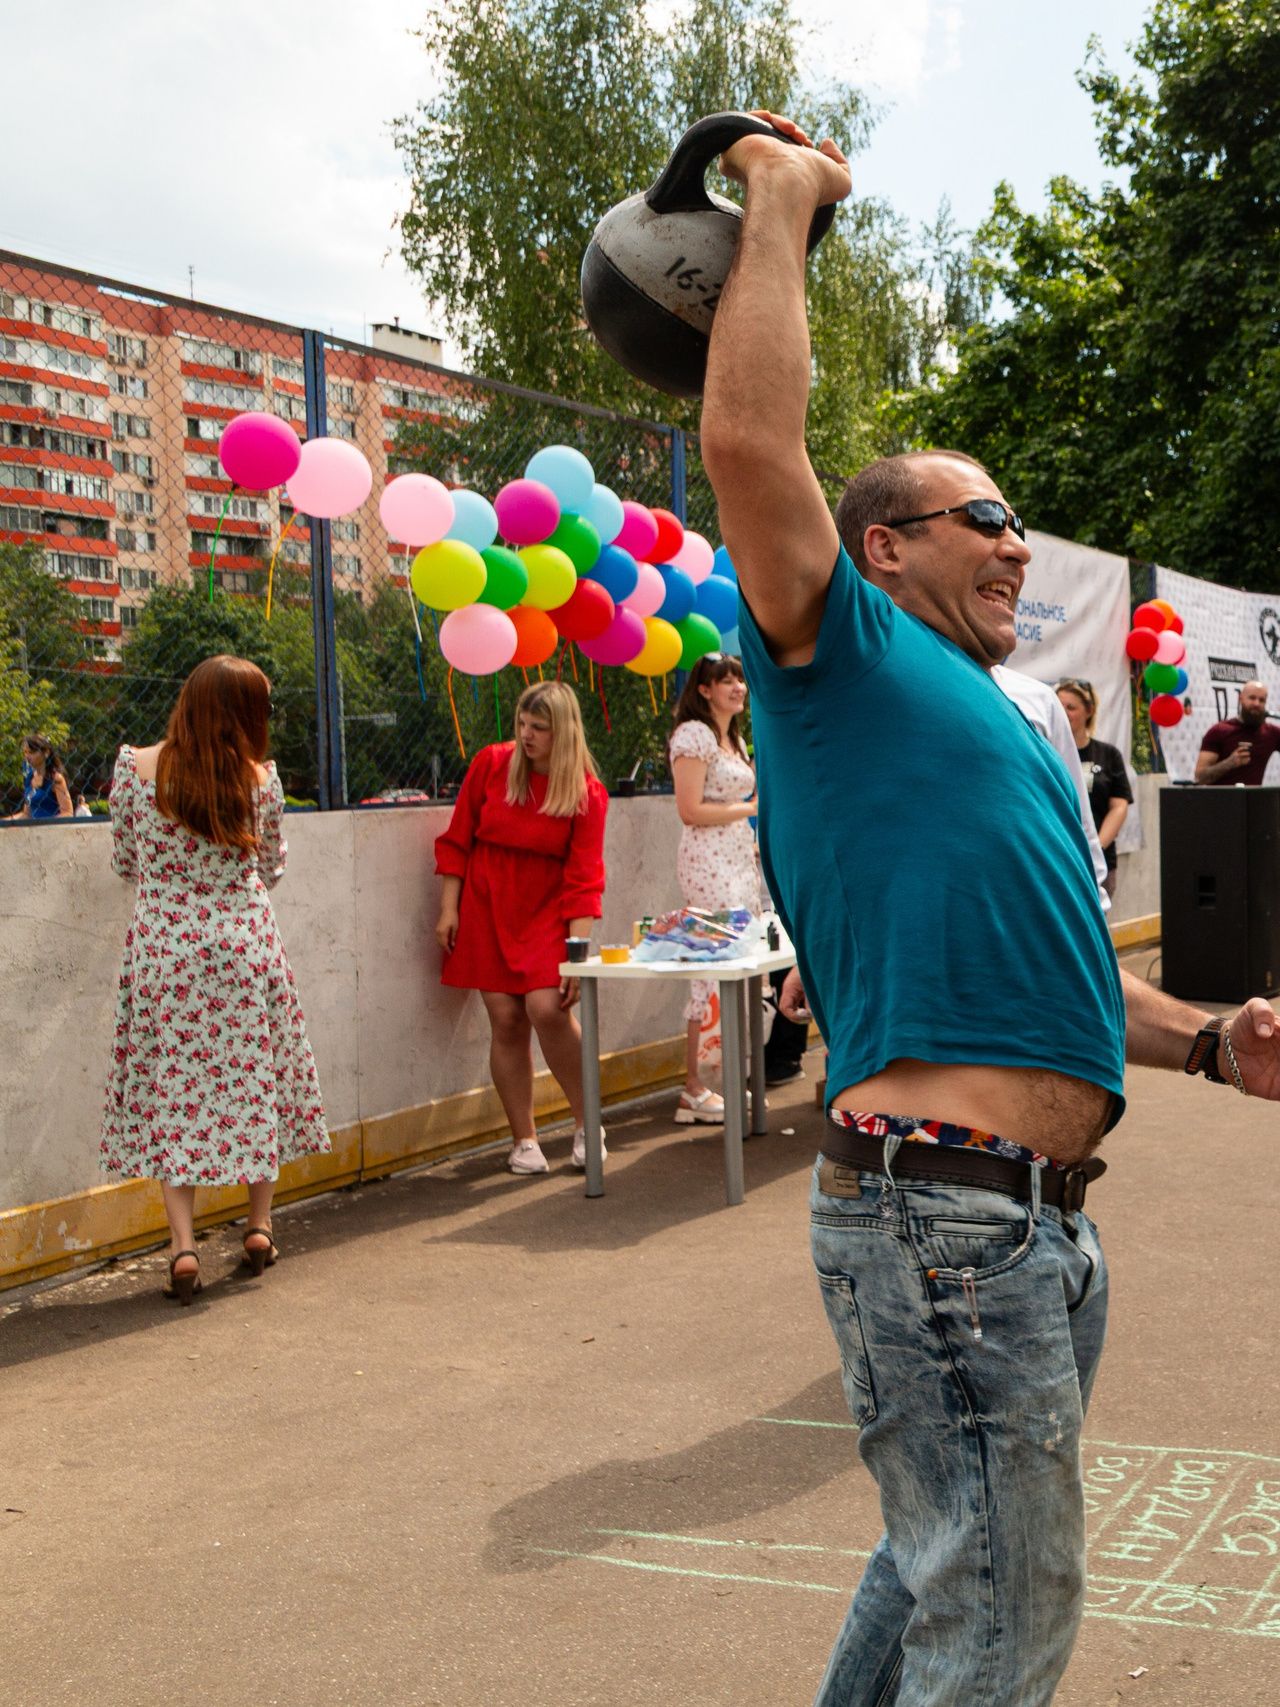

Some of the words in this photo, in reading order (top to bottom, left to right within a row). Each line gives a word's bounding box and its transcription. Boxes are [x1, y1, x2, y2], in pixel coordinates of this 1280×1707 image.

[1015, 599, 1067, 623] ОНАЛЬНОЕ
[1014, 622, 1042, 642] АСИЕ
[1094, 1459, 1231, 1562] ВАРДАН
